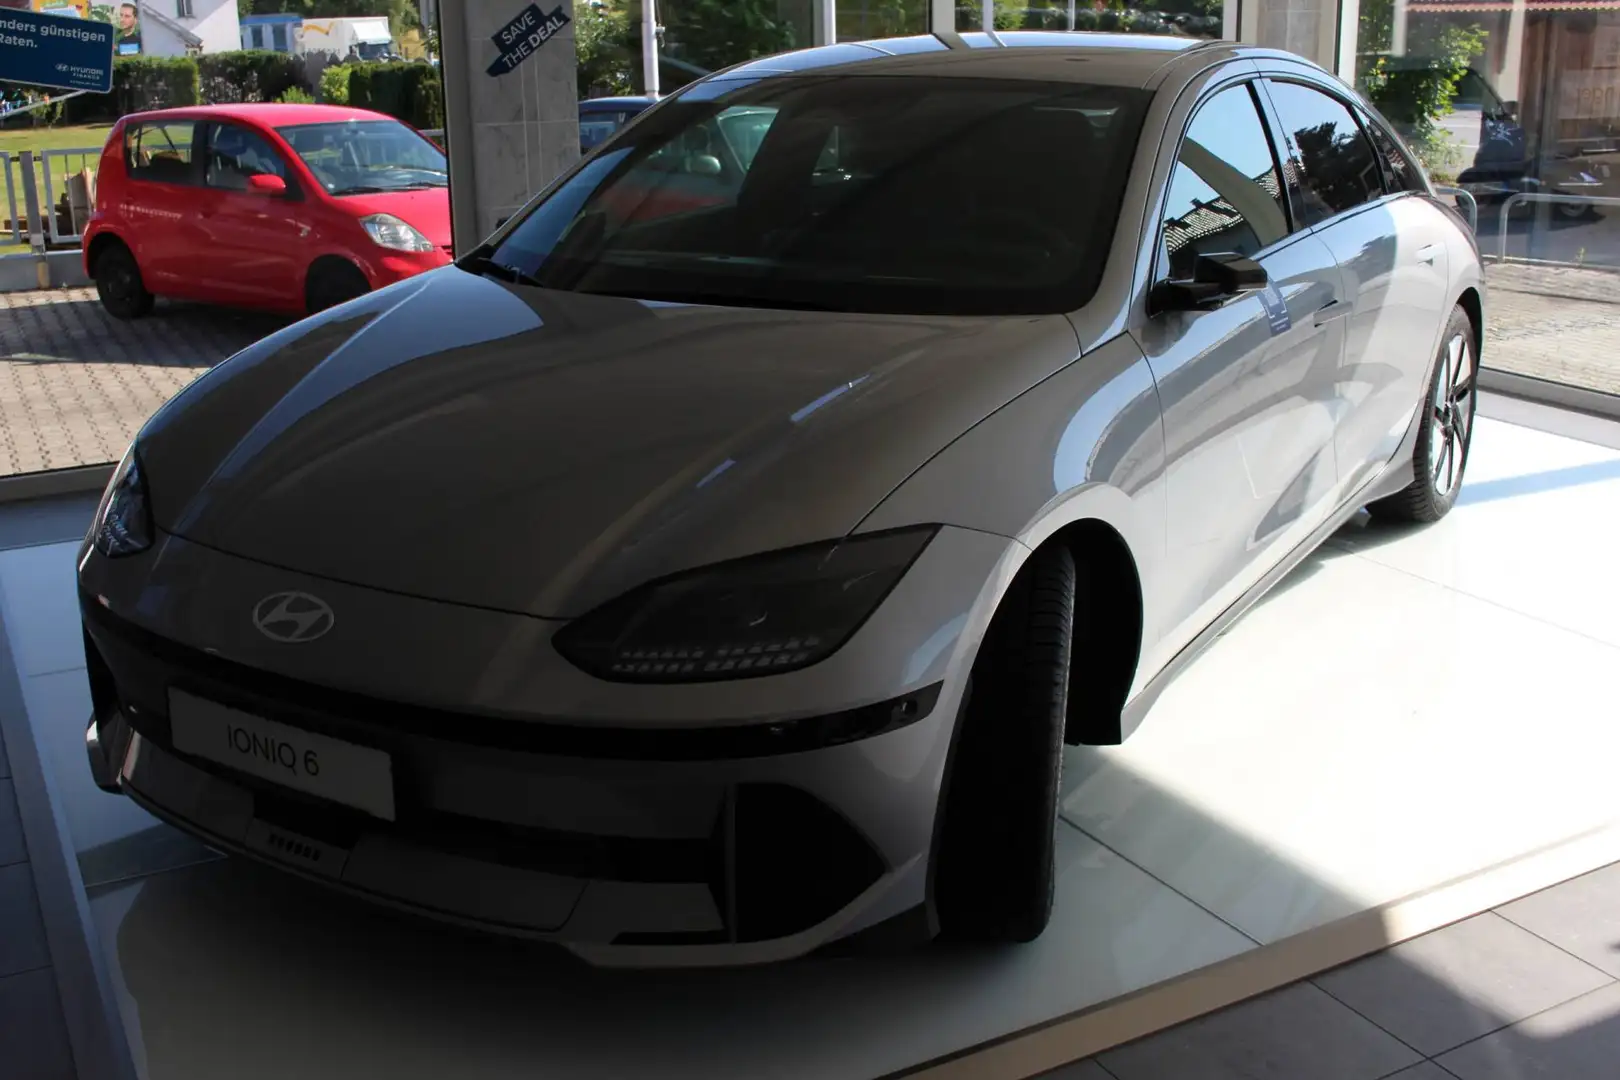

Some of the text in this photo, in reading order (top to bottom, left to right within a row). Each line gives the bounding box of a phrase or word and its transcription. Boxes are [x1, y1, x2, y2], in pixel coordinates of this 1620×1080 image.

[40, 24, 106, 43] günstigen
[502, 10, 536, 45] SAVE
[502, 16, 564, 68] THE DEAL
[70, 66, 104, 76] HYUNDAI
[226, 723, 320, 776] IONIQ 6
